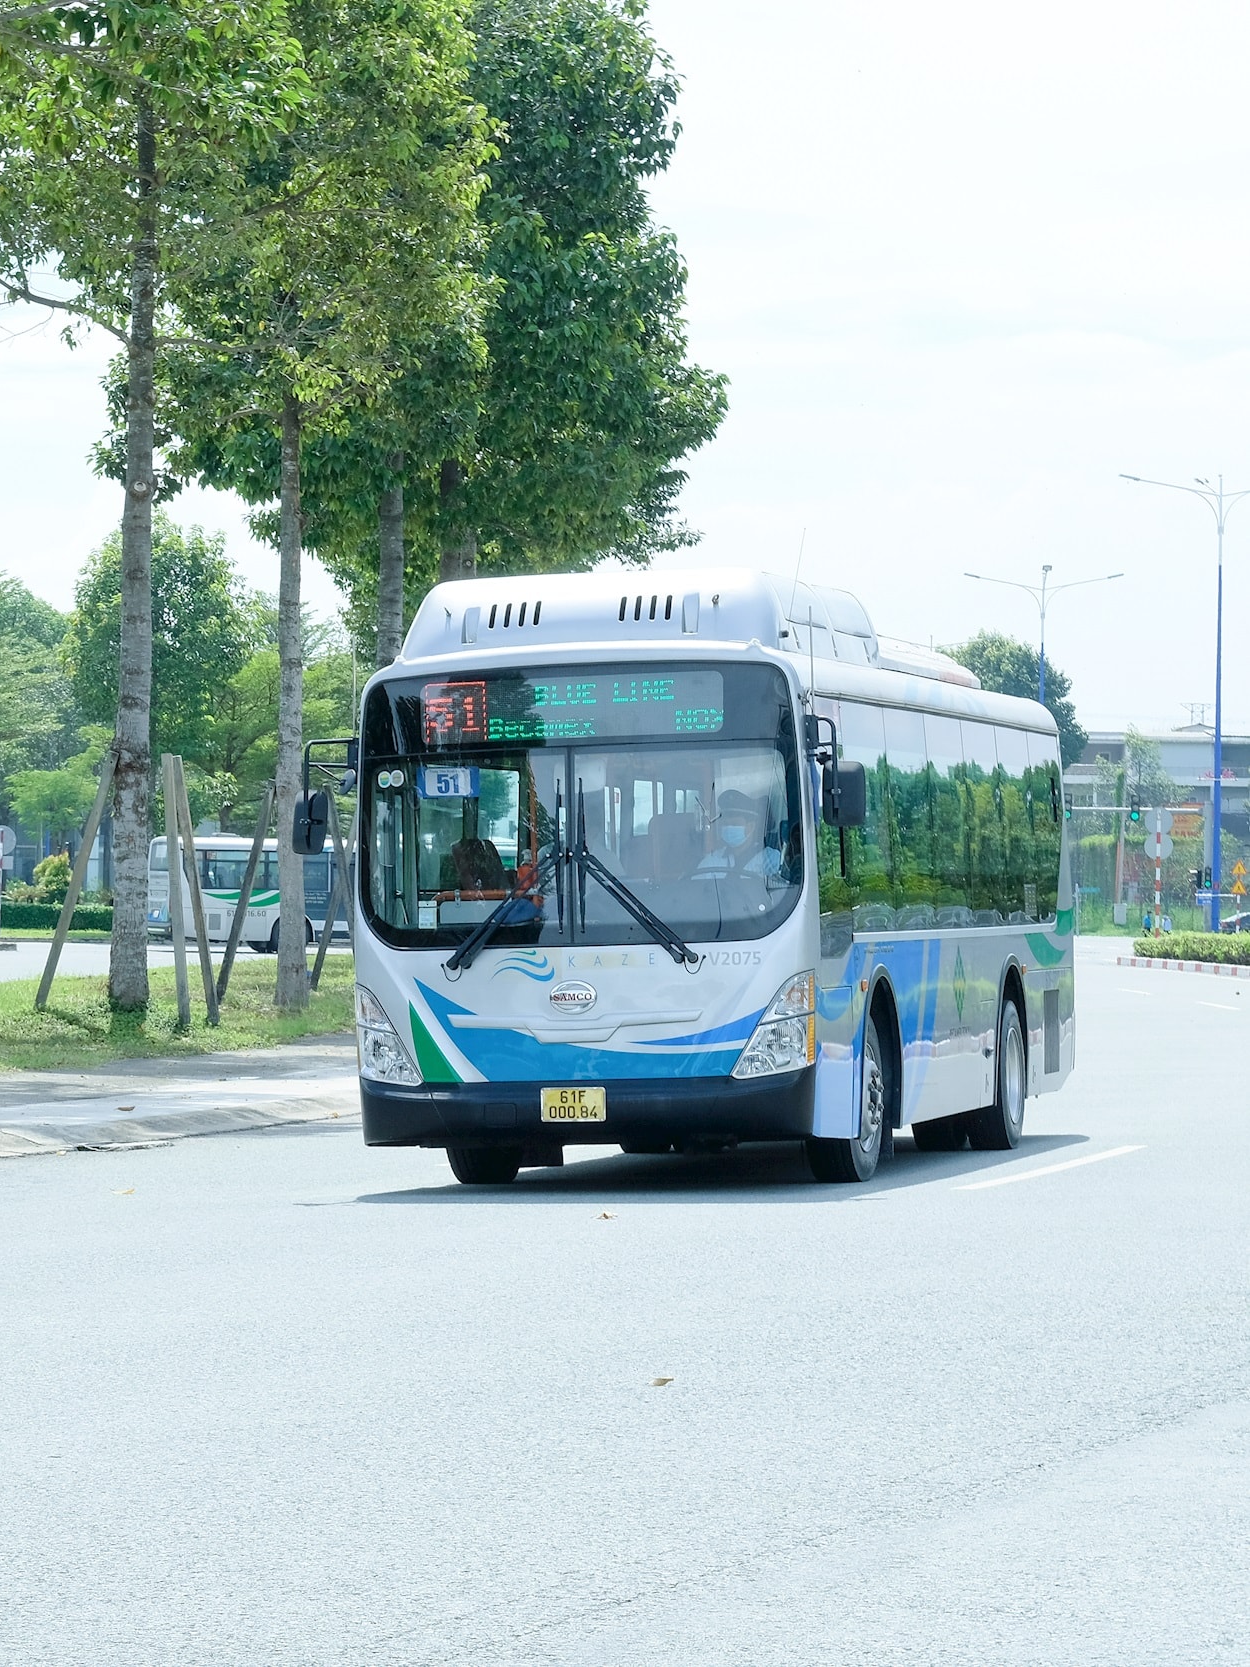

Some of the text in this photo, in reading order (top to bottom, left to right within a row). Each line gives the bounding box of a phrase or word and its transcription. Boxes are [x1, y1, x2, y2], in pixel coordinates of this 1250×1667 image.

[534, 680, 675, 706] BLUE LINE
[436, 773, 460, 794] 51
[567, 950, 762, 969] KAZE V2075
[552, 992, 593, 1002] SAMCO
[560, 1090, 587, 1104] 61F
[549, 1105, 598, 1119] 000.84
